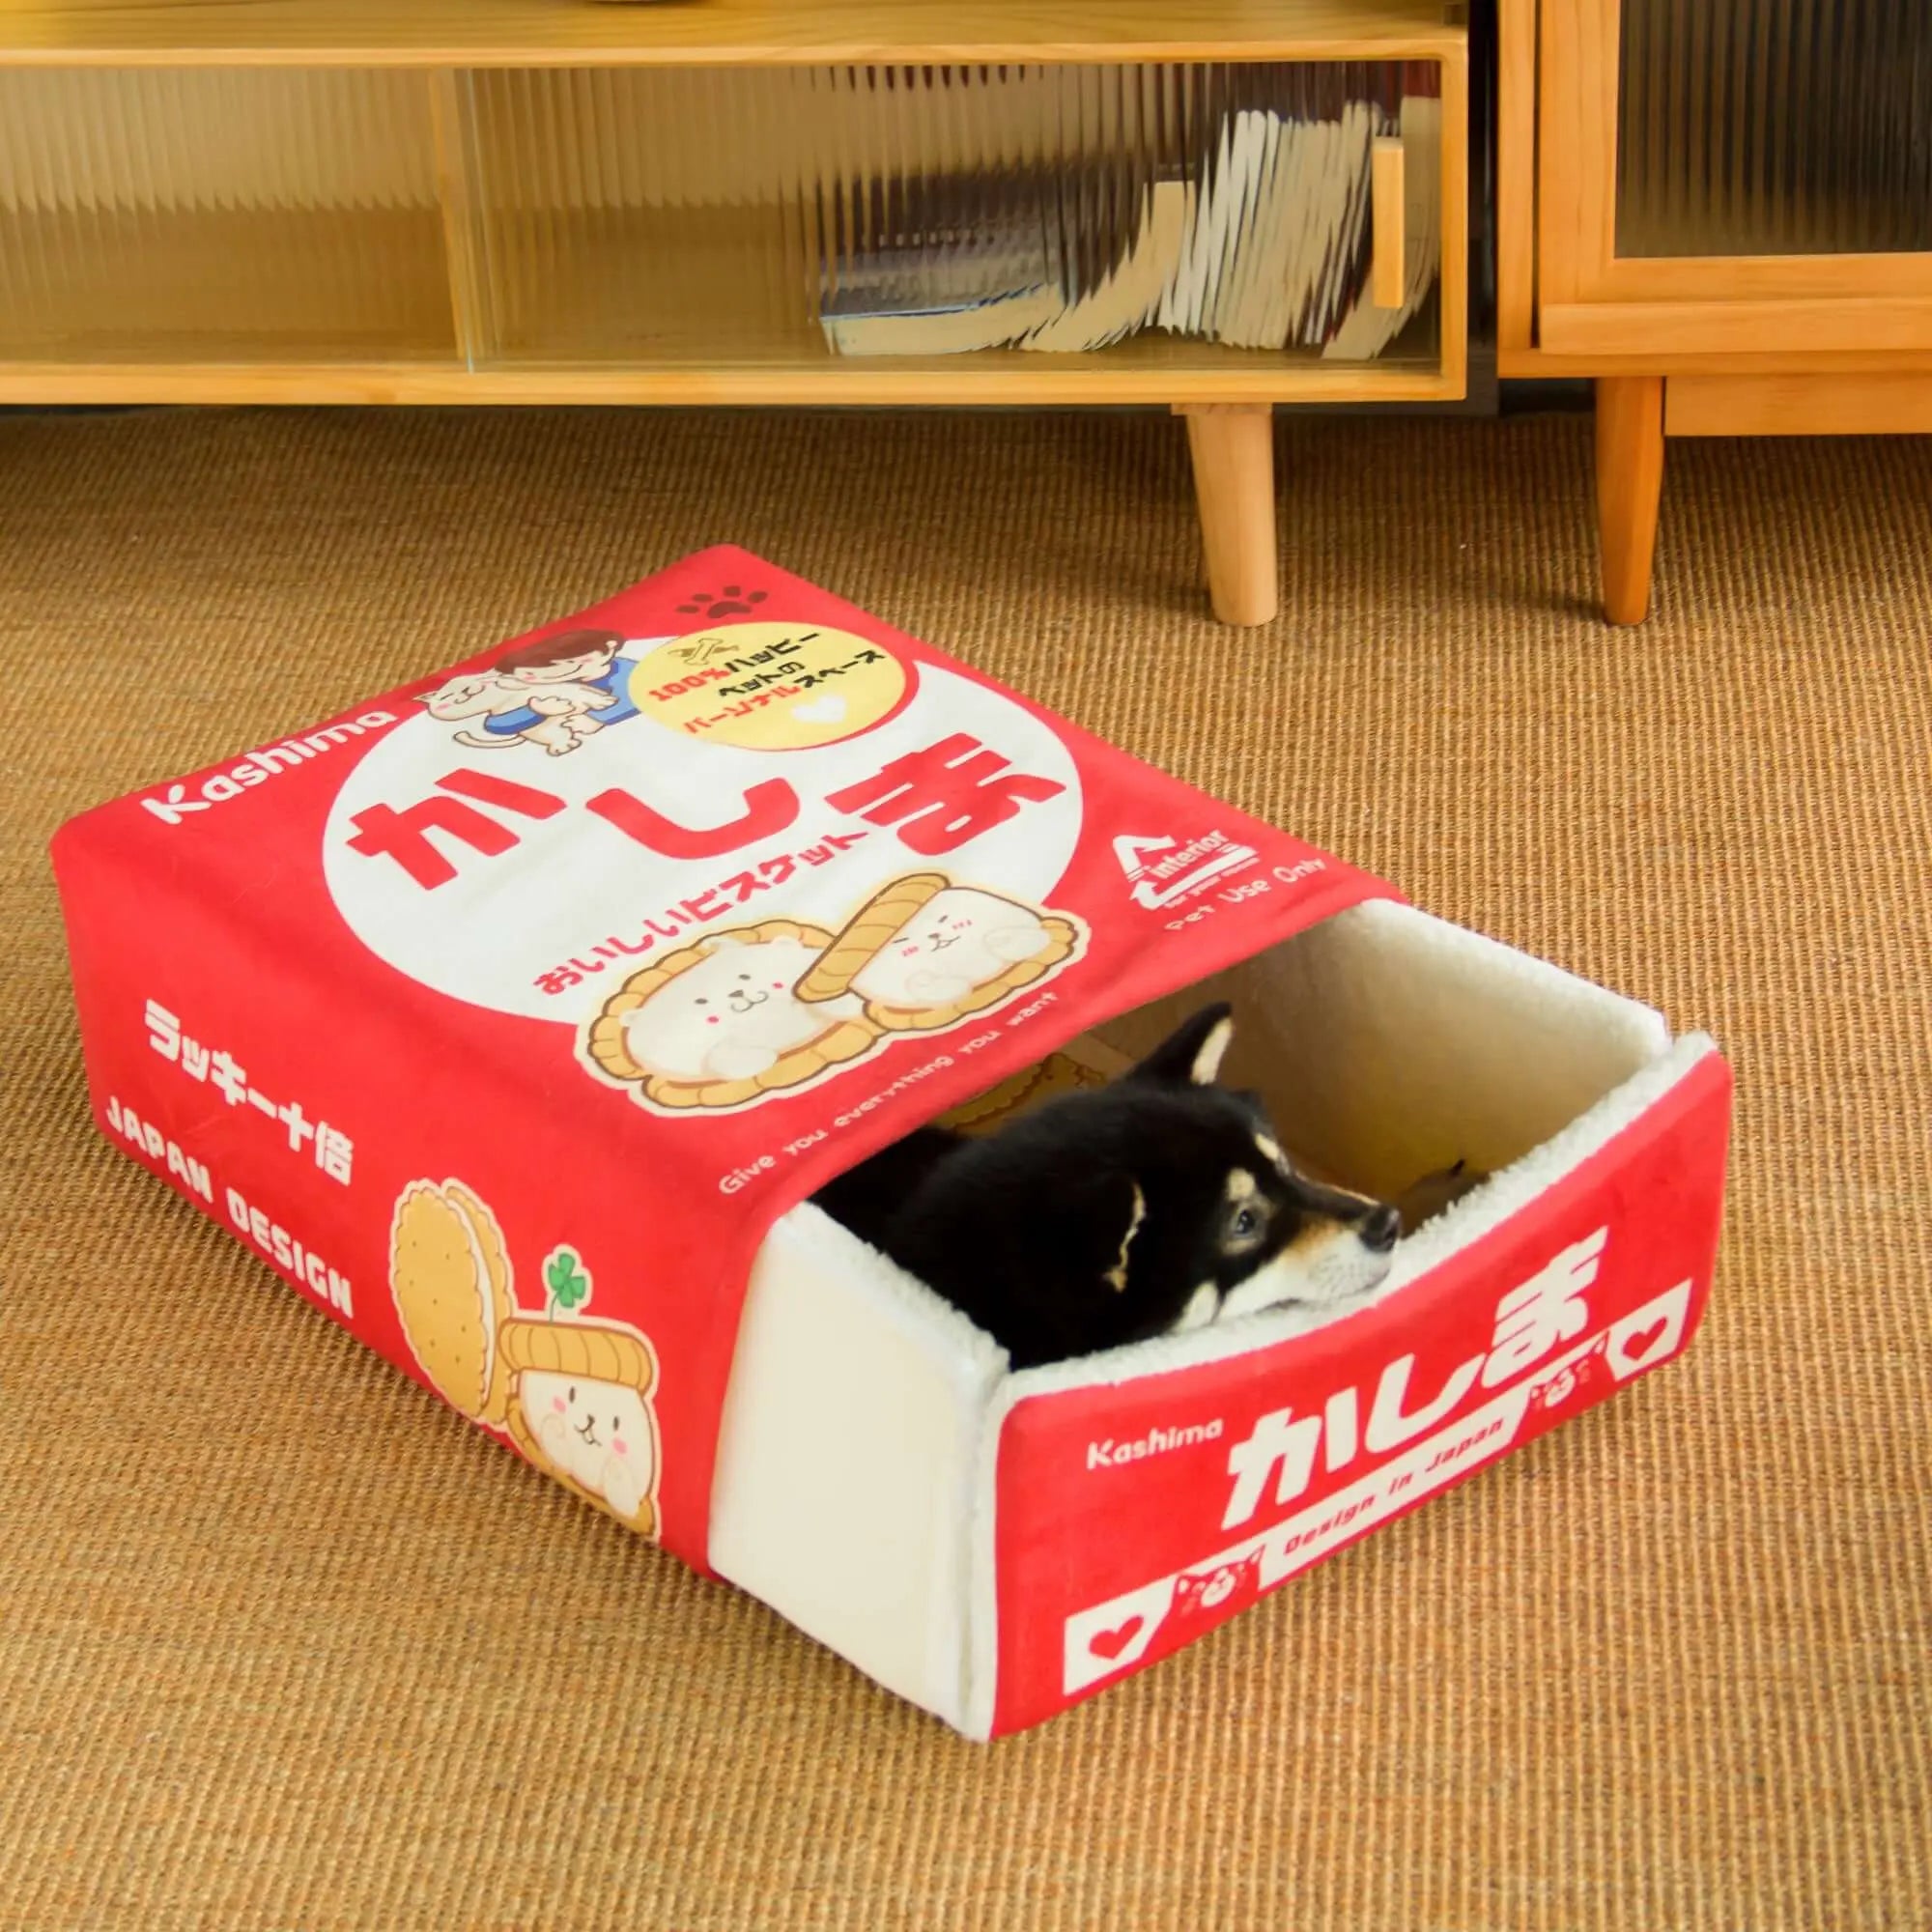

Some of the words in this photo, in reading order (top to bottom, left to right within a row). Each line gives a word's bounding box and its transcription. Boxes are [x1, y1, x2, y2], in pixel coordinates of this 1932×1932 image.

[141, 709, 398, 825] Kashima
[346, 732, 1067, 891] かしま
[532, 832, 869, 995] おいしいビスケット
[1164, 904, 1215, 930] Pet
[1217, 879, 1272, 903] Use
[1272, 858, 1326, 883] Only
[145, 999, 354, 1186] ラッキー十倍
[719, 1155, 776, 1194] Give
[834, 1056, 954, 1127] everything
[1007, 991, 1059, 1026] want
[106, 1095, 213, 1203] JAPAN
[226, 1187, 354, 1319] DESIGN
[1087, 1418, 1224, 1468] Kashima
[1221, 1225, 1609, 1530] かしま
[1284, 1495, 1376, 1555] Design
[1425, 1417, 1504, 1472] Japan
